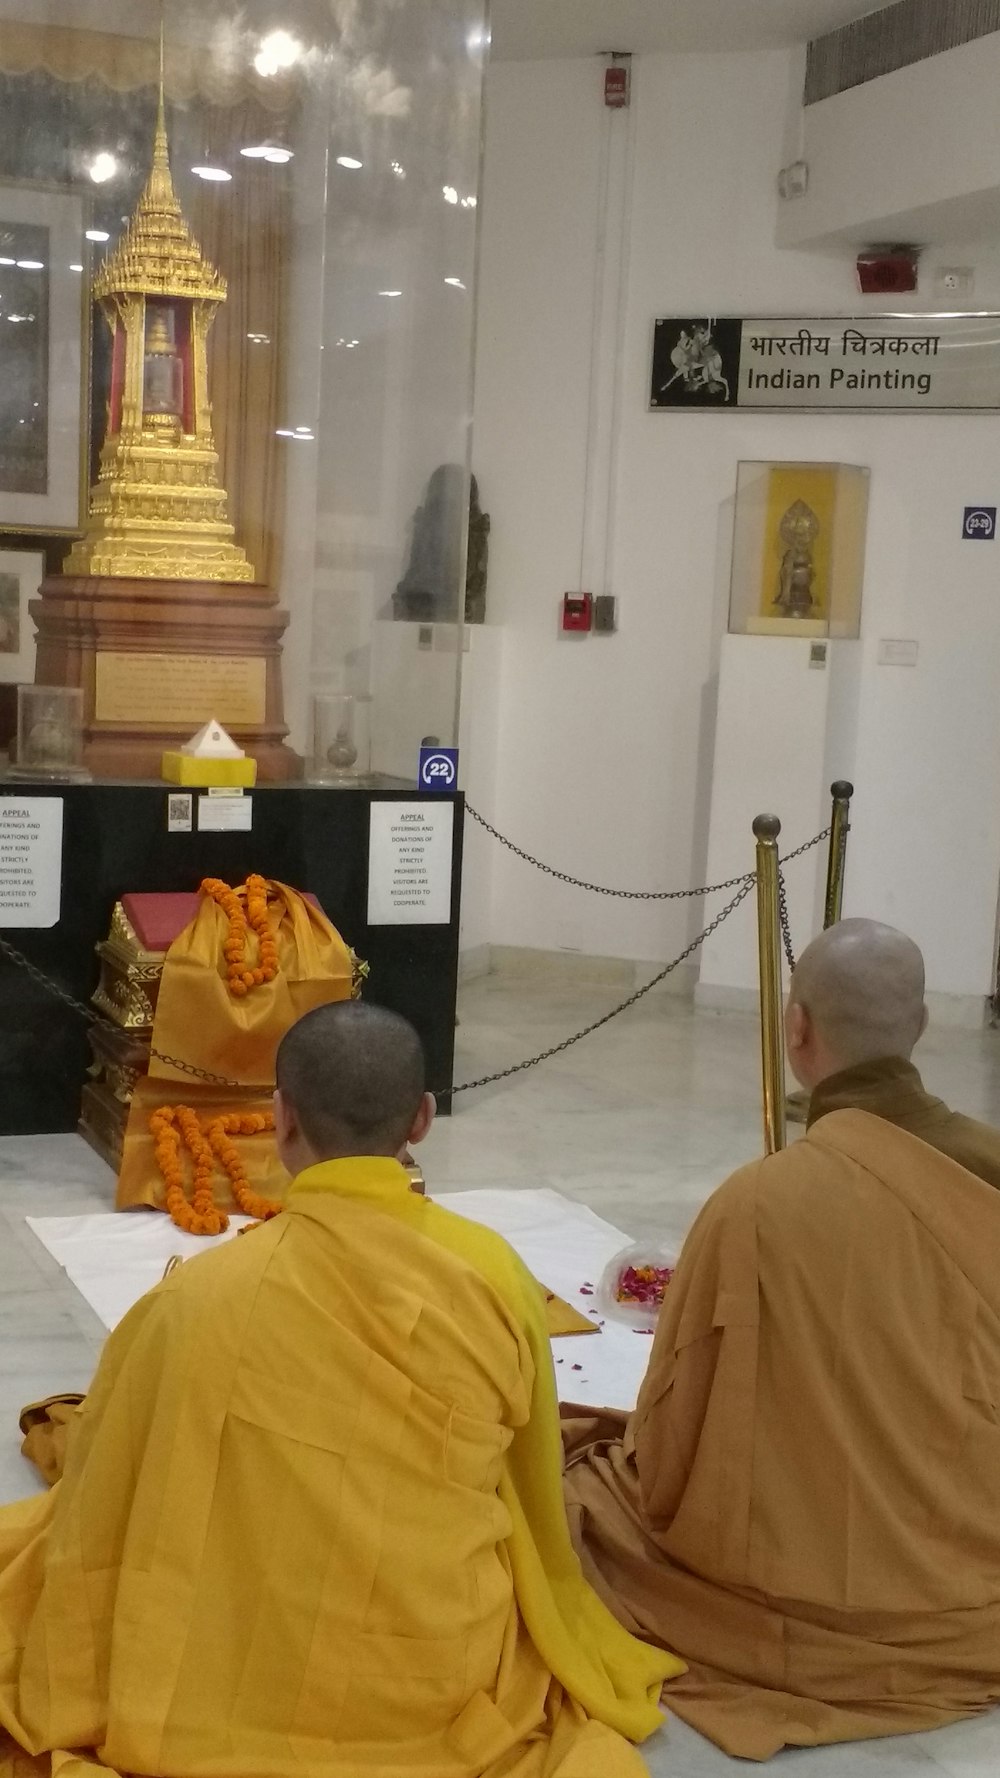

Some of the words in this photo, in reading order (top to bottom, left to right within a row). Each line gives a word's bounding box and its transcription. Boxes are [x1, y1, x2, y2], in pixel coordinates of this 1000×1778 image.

[750, 329, 831, 356] भारतीय
[841, 329, 941, 356] चित्रकला
[748, 368, 820, 390] Indian
[830, 368, 931, 395] Painting
[430, 762, 449, 776] 22
[2, 809, 31, 818] APPEAL
[400, 814, 425, 822] APPEAL
